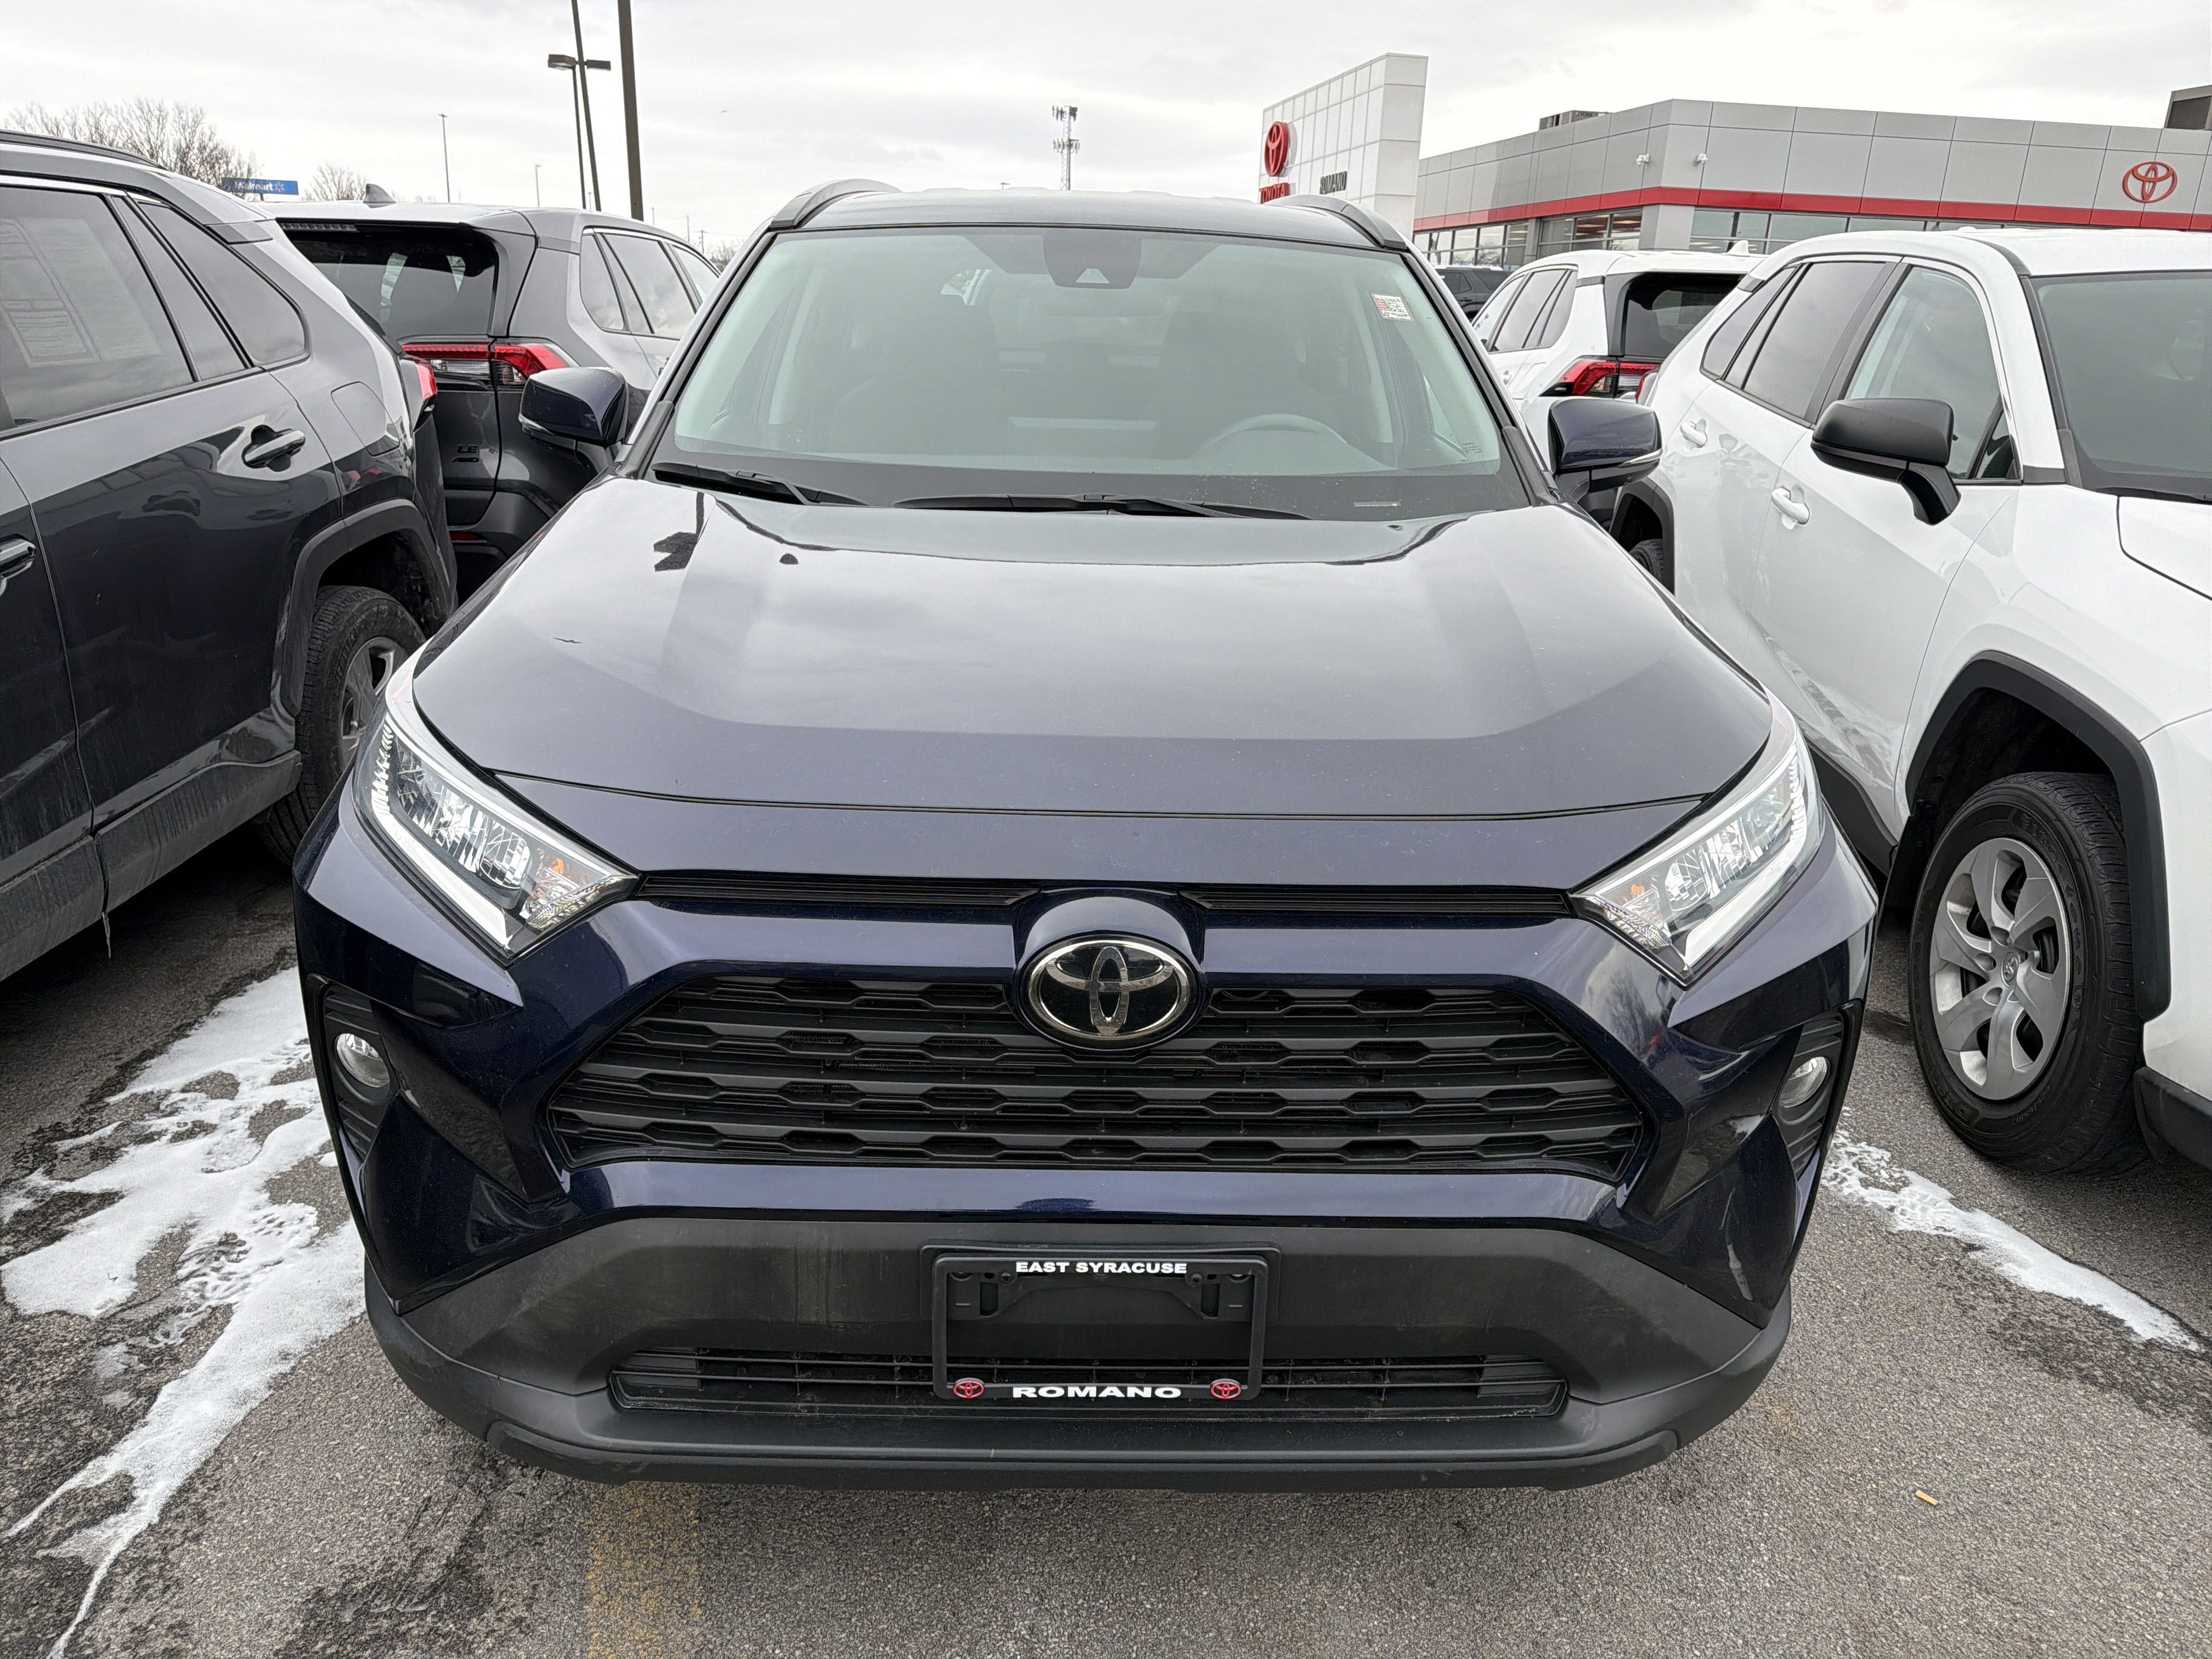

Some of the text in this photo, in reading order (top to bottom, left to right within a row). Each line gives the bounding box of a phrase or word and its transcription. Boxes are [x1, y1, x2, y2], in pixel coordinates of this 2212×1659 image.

[1260, 183, 1289, 204] TOYOTA
[1016, 1262, 1187, 1273] EAST SYRACUSE
[1012, 1386, 1181, 1398] ROMANO
